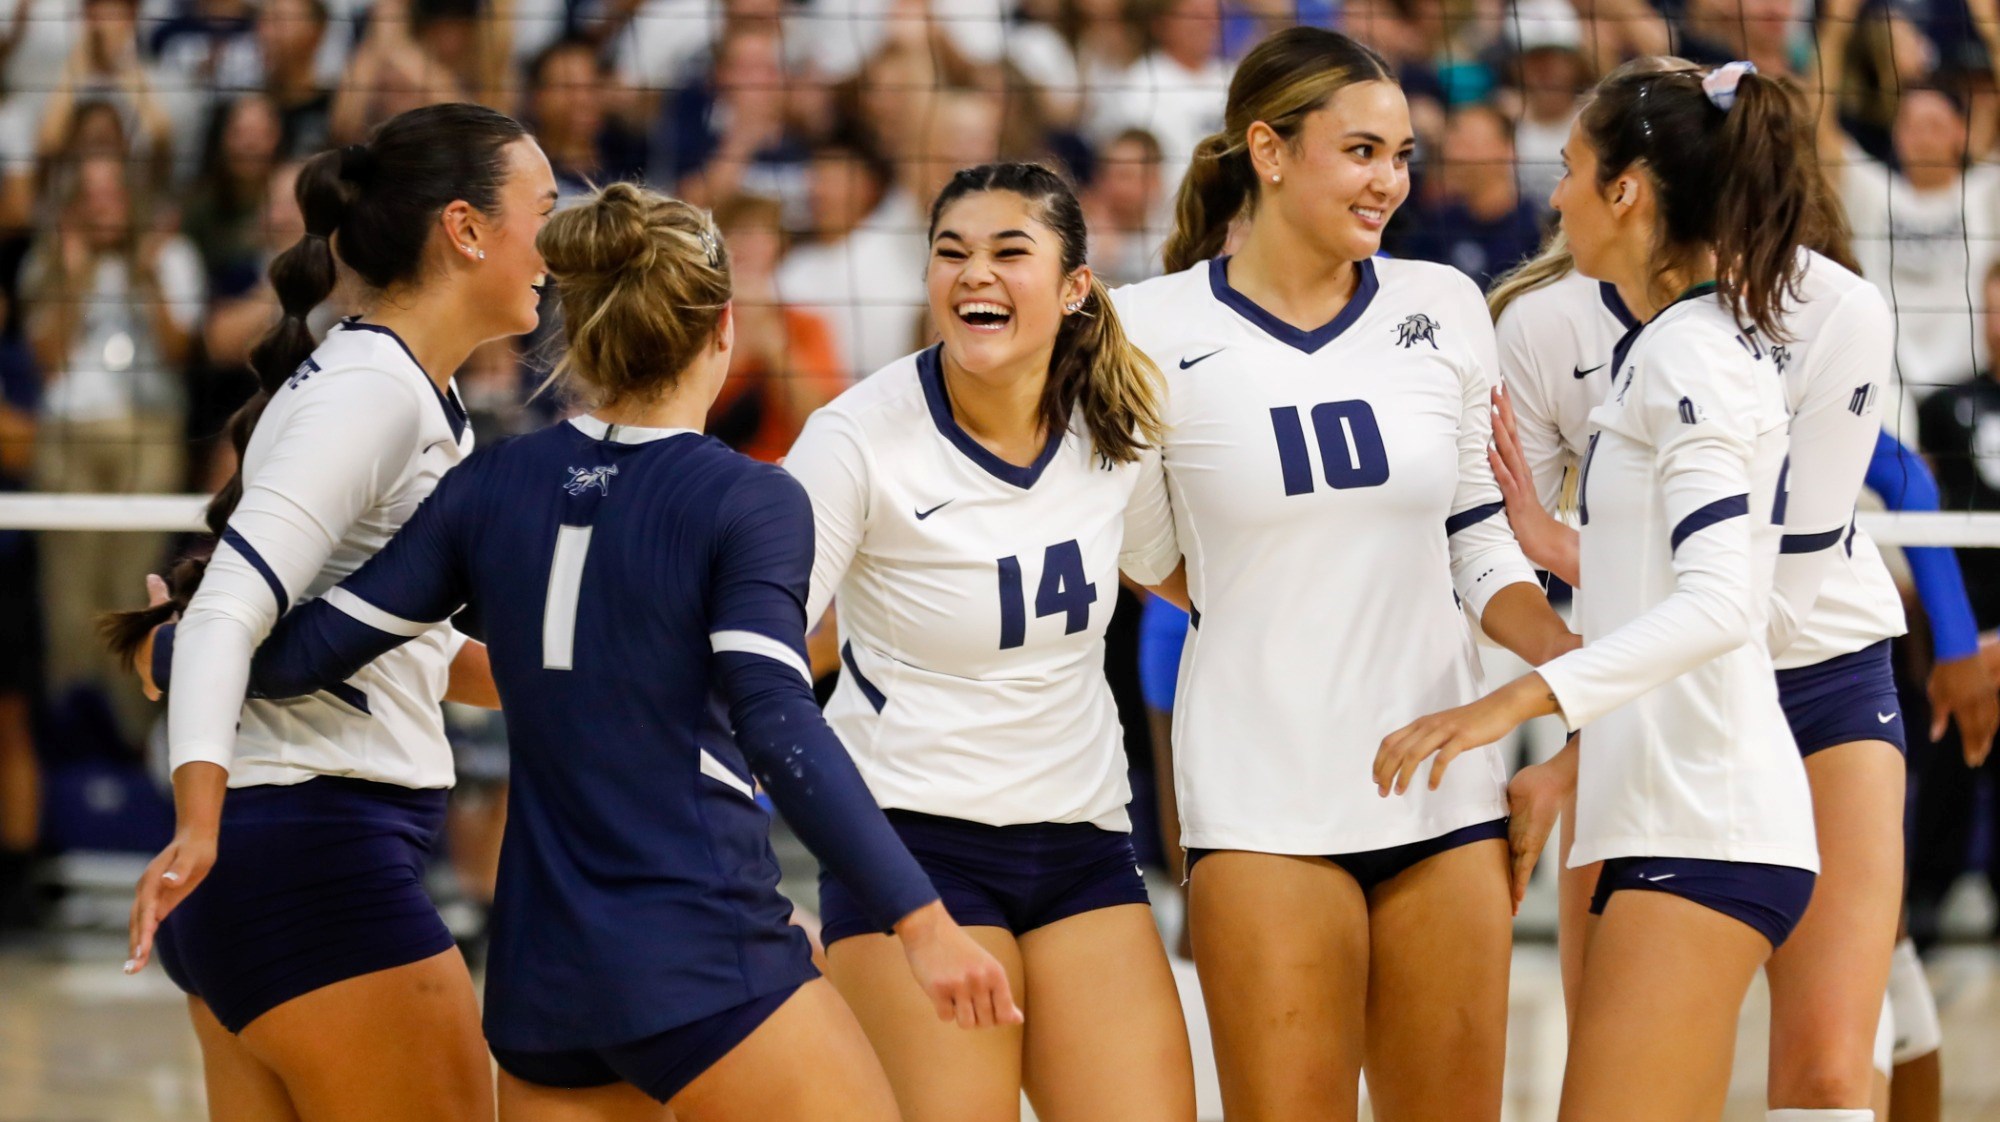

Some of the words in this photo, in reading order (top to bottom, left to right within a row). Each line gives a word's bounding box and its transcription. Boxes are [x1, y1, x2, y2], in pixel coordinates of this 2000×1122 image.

[1269, 399, 1390, 496] 10
[542, 524, 593, 671] 1
[996, 538, 1098, 650] 14
